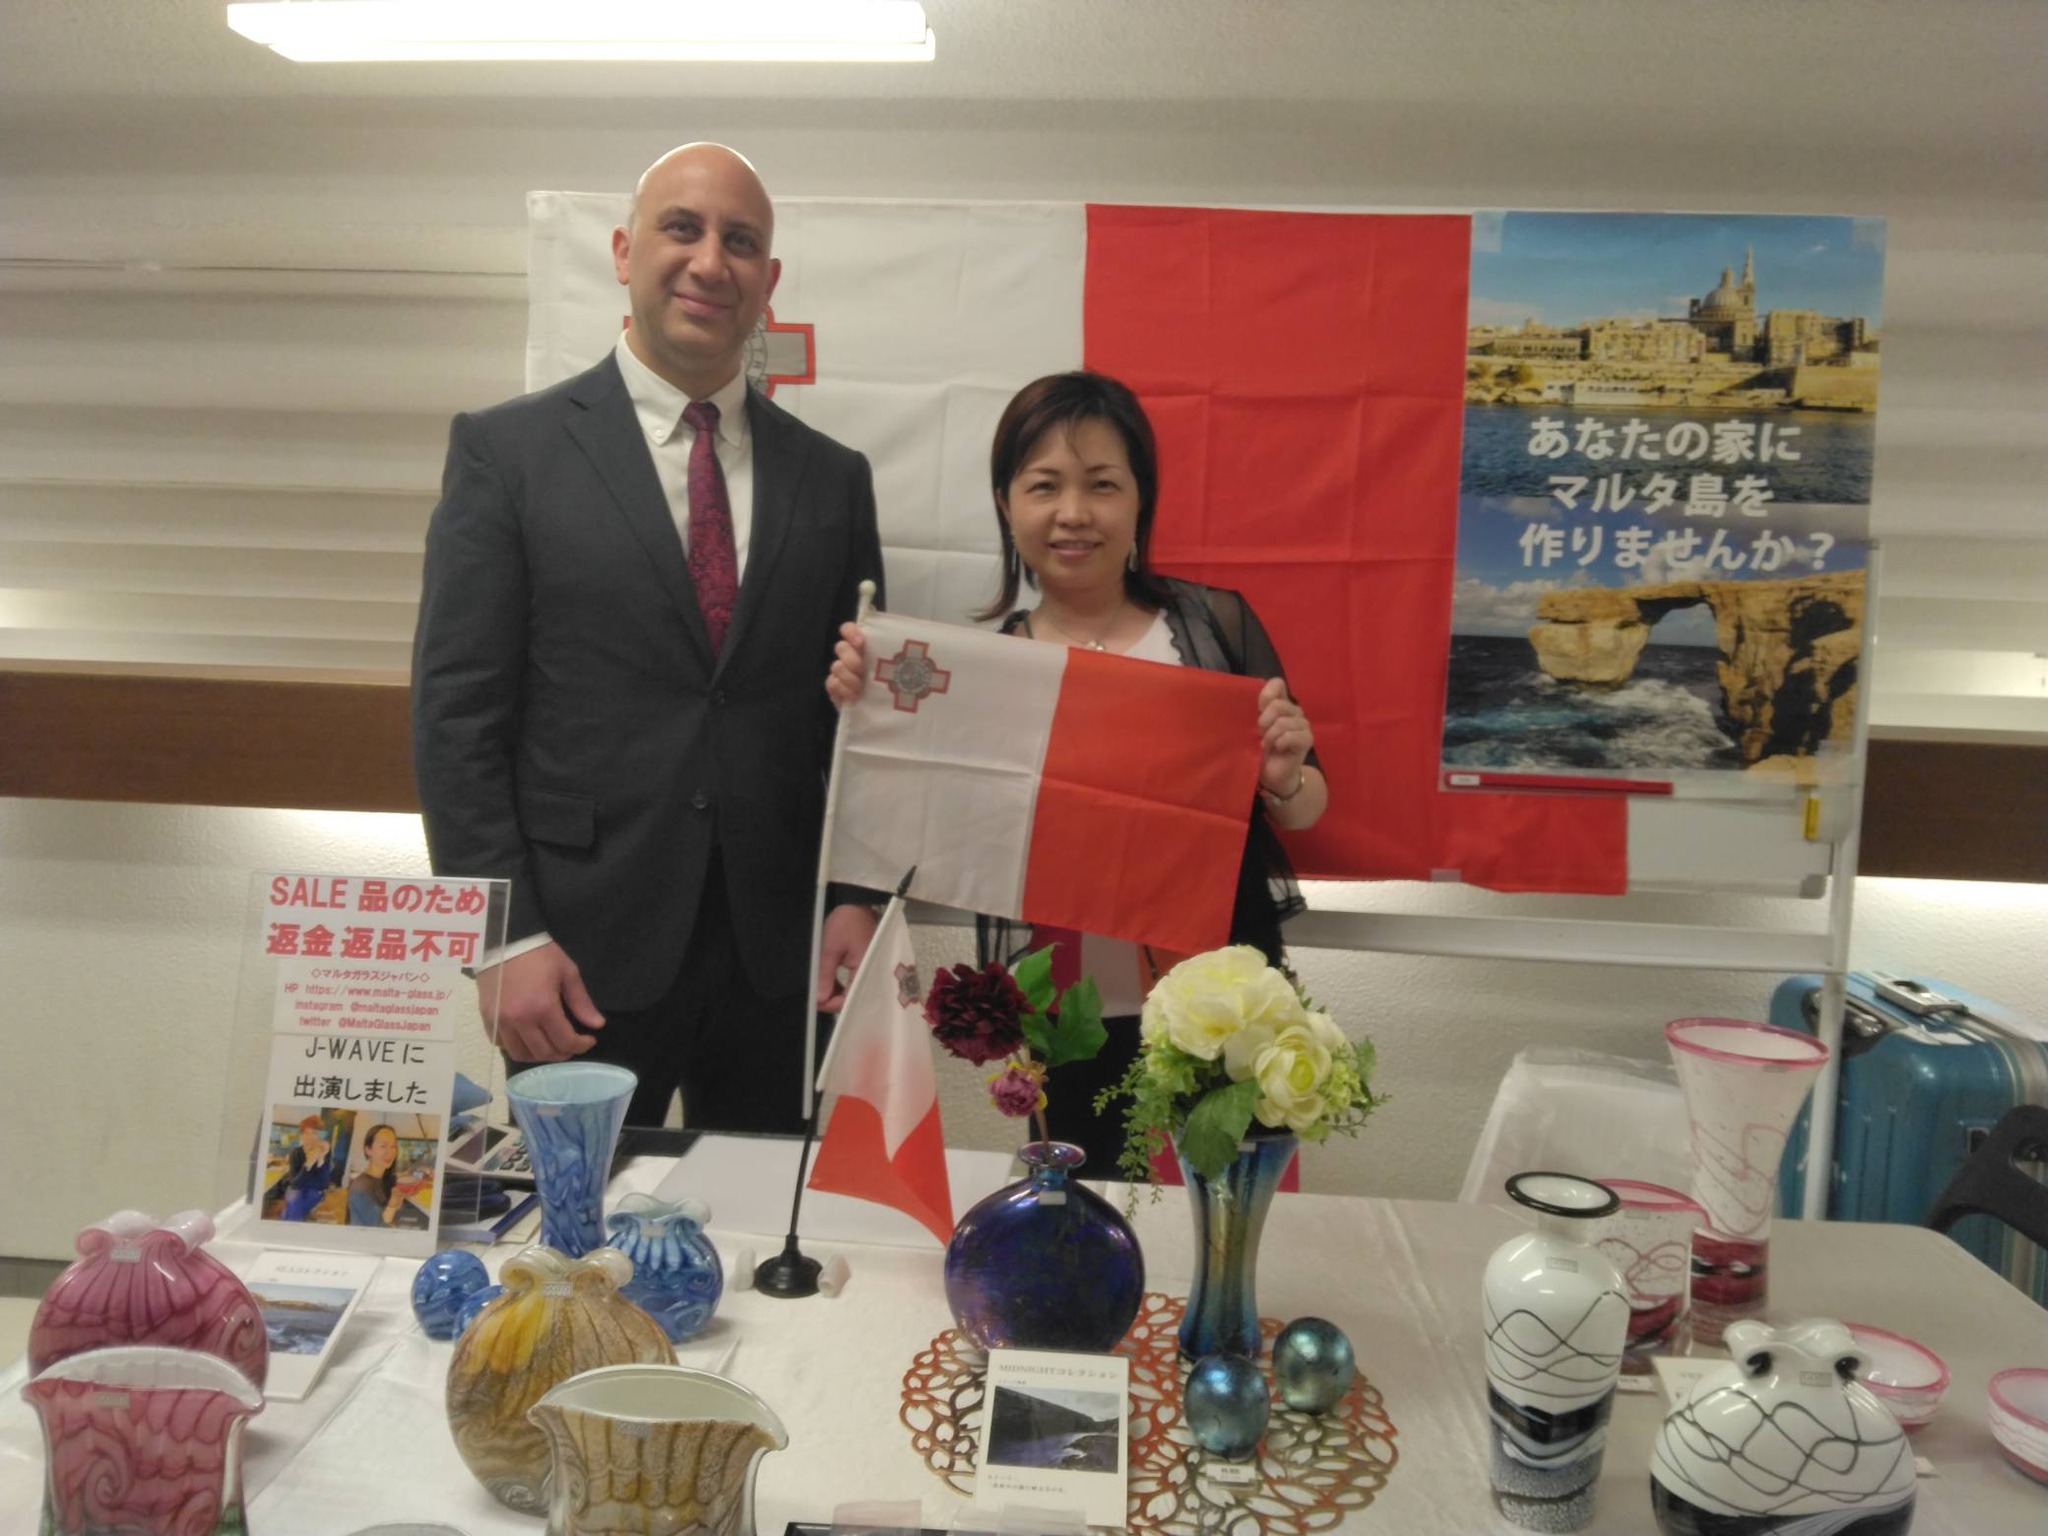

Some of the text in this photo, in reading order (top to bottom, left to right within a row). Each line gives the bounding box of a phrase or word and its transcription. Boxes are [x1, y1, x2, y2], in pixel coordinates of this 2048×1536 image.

[1527, 415, 1801, 464] あなたの家に
[1548, 473, 1776, 518] マルタ島を
[1518, 523, 1835, 571] 作りませんか？
[269, 876, 486, 915] SALE 品のため
[293, 1074, 427, 1104] 出演しました
